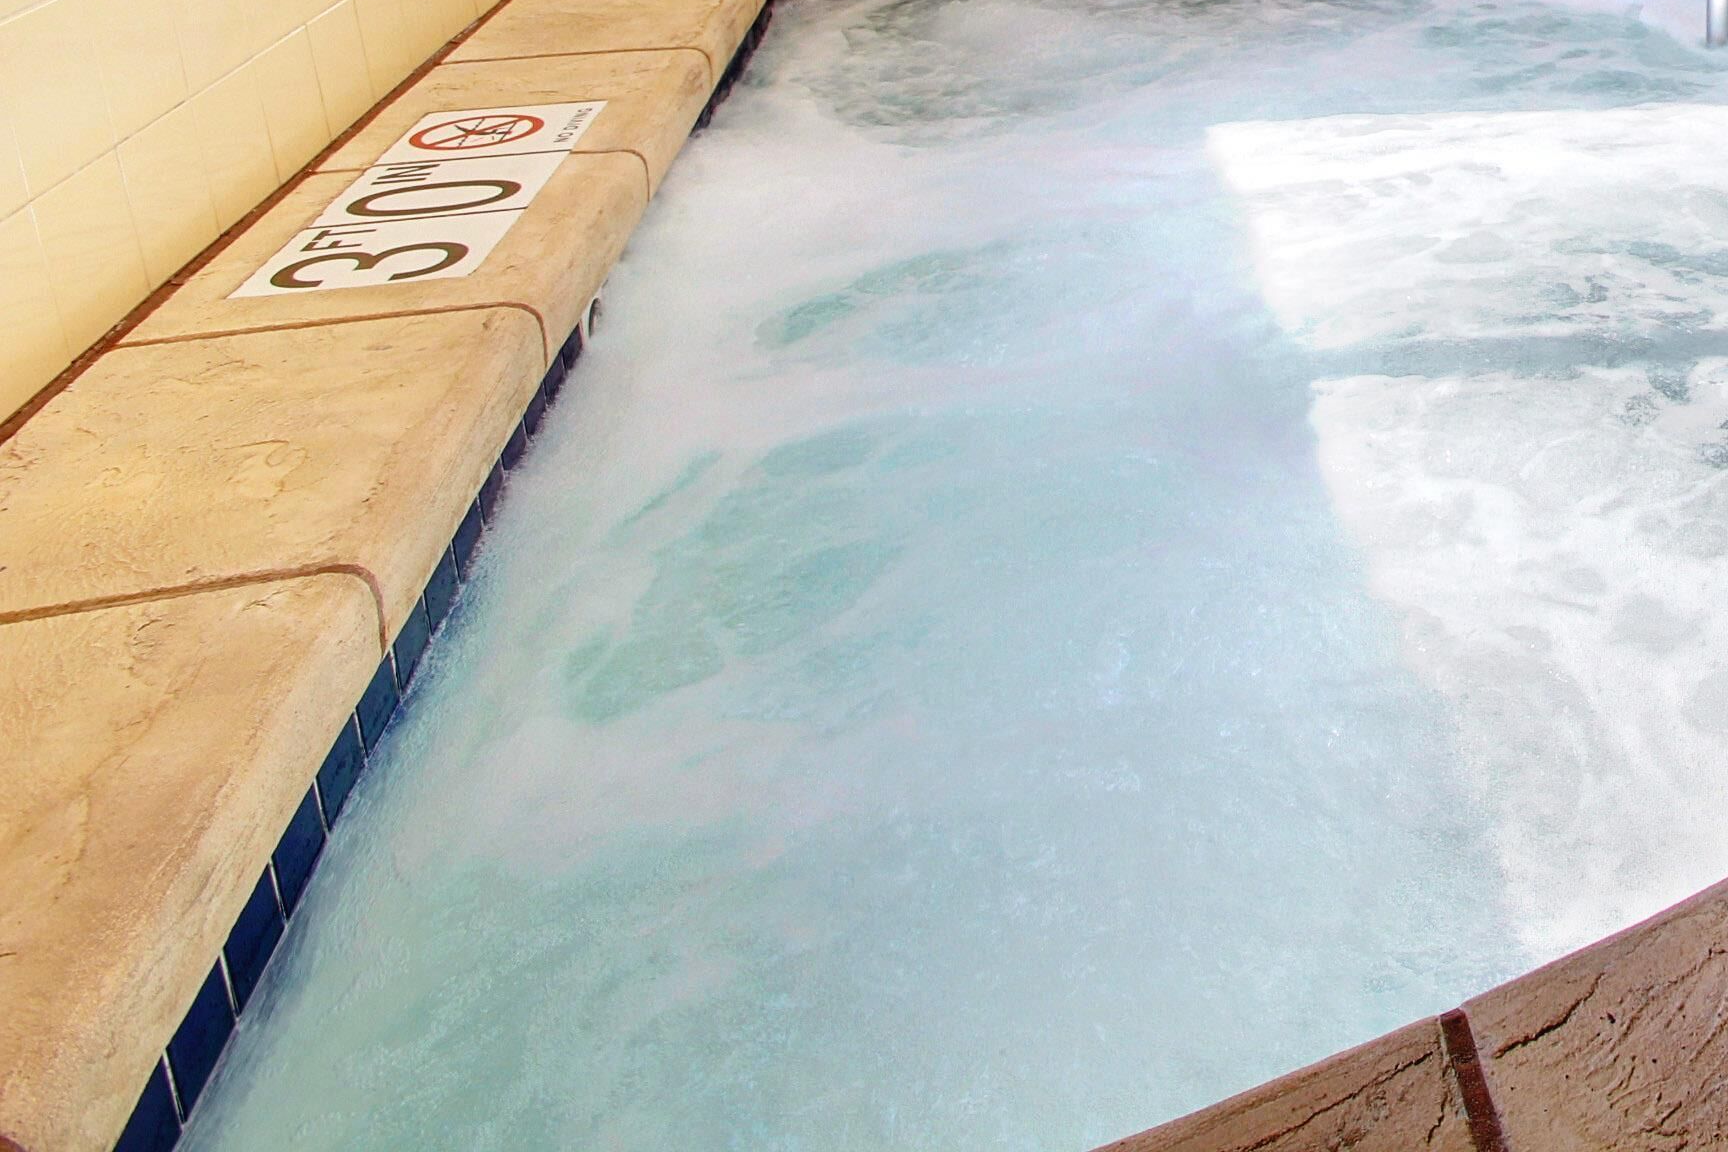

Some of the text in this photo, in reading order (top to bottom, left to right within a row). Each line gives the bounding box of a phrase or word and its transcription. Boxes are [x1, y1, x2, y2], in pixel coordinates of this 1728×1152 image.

[553, 107, 593, 143] NO DIVING
[269, 163, 522, 289] 3 FT 0 IN
